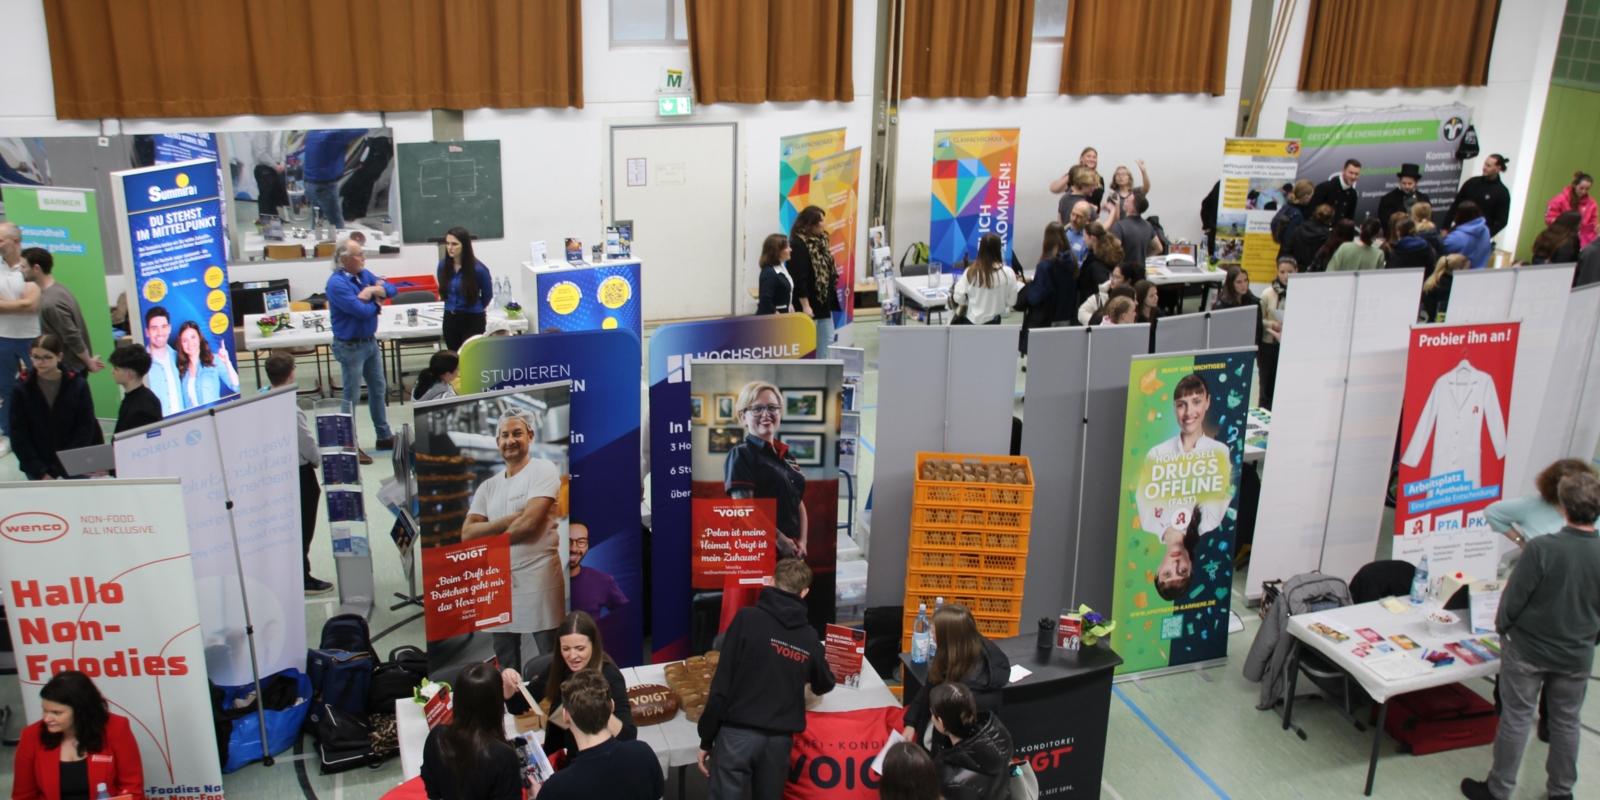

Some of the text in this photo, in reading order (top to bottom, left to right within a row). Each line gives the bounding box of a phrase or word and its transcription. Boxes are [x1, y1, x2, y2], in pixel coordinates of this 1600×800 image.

[667, 74, 682, 88] M
[149, 207, 203, 228] DU STEHST
[136, 216, 217, 241] IM MITTELPUNKT
[1419, 332, 1465, 347] Probier
[1468, 330, 1487, 344] ihn
[481, 364, 570, 383] STUDIEREN
[670, 422, 682, 434] In
[671, 442, 692, 452] 3 Ho
[1156, 449, 1215, 464] HOW TO SELL
[670, 467, 676, 475] 6
[1151, 459, 1218, 481] DRUGS
[1145, 475, 1223, 499] OFFLINE
[1408, 473, 1461, 494] Arbeitsplatz
[80, 514, 135, 523] NON-FOOD
[713, 508, 754, 517] VOIGT
[6, 523, 62, 532] wenco
[82, 526, 155, 535] ALL INCLUSIVE
[1438, 519, 1458, 530] PTA
[731, 528, 741, 537] ist
[742, 528, 767, 537] meine
[700, 539, 768, 552] Heimat, Voigt ist
[446, 547, 487, 562] VOIGT
[701, 554, 721, 562] mein
[463, 568, 485, 581] Duft
[486, 566, 500, 576] der
[11, 576, 124, 608] Hallo
[430, 578, 505, 601] Brötchen geht mir
[437, 602, 452, 612] das
[455, 597, 476, 608] Herz
[18, 617, 121, 645] Non-
[770, 642, 809, 663] VOIGT
[26, 648, 189, 681] Foodies
[628, 691, 670, 706] VOIGT
[838, 739, 885, 750] KONDI
[1021, 736, 1074, 752] KONDITOREI
[201, 784, 221, 793] No
